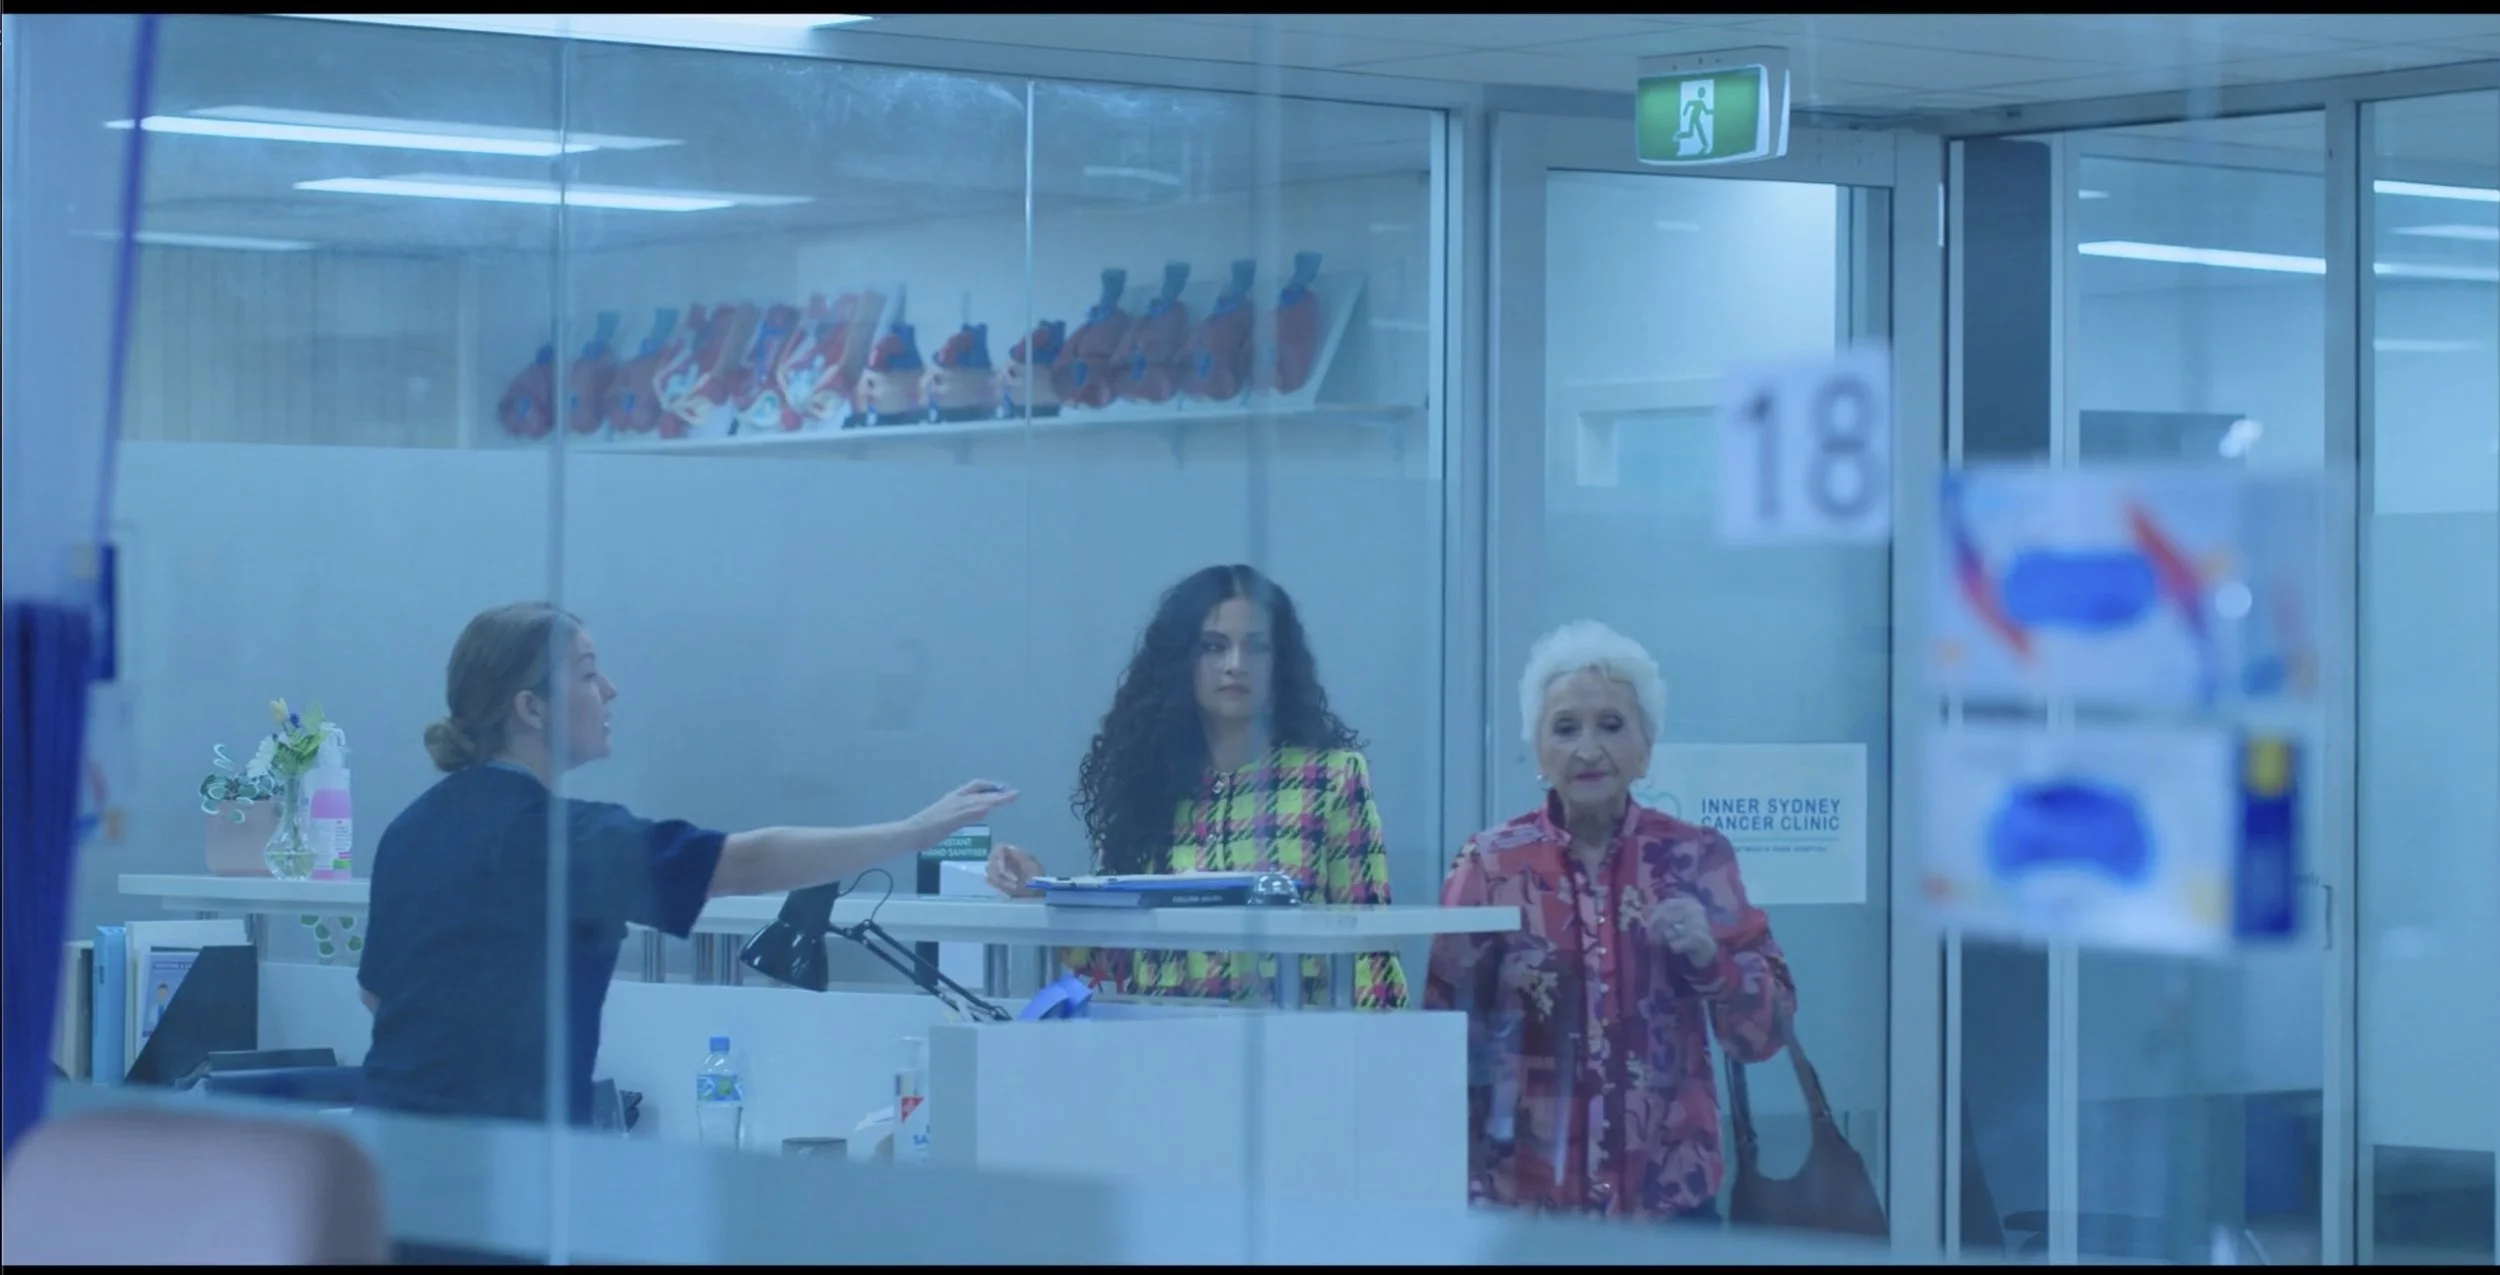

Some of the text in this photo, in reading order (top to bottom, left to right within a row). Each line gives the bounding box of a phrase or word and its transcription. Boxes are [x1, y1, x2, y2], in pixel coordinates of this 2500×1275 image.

[1733, 377, 1879, 522] 18
[1702, 798, 1840, 814] INNER SYDNEY
[1701, 816, 1840, 831] CANCER CLINIC
